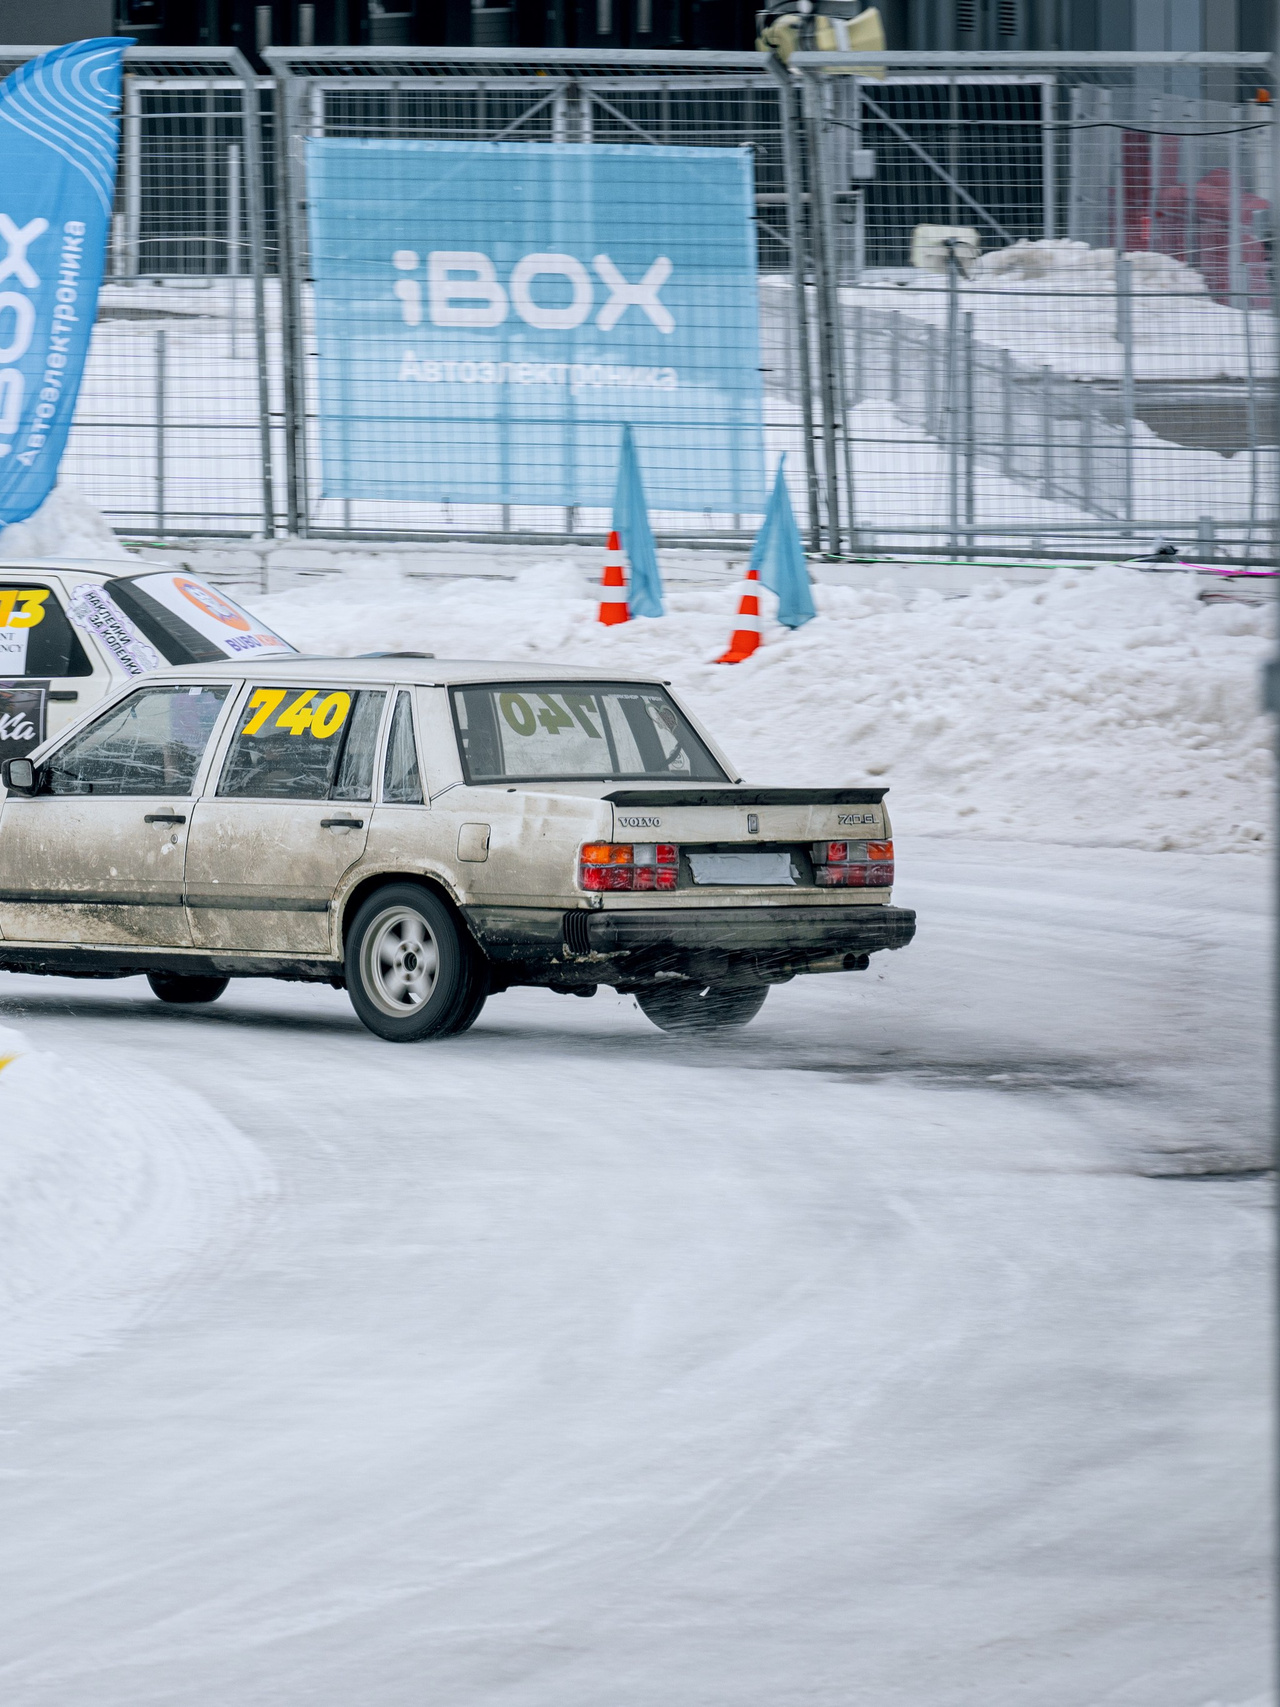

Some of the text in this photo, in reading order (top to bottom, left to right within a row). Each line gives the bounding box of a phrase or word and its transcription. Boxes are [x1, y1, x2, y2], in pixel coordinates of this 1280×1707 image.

[392, 250, 676, 334] iBOX
[17, 220, 86, 467] Автоэлектроника
[397, 350, 679, 395] Автоэлектроника
[88, 614, 104, 629] ЗА
[241, 689, 351, 739] 740
[618, 817, 662, 827] VOLVO
